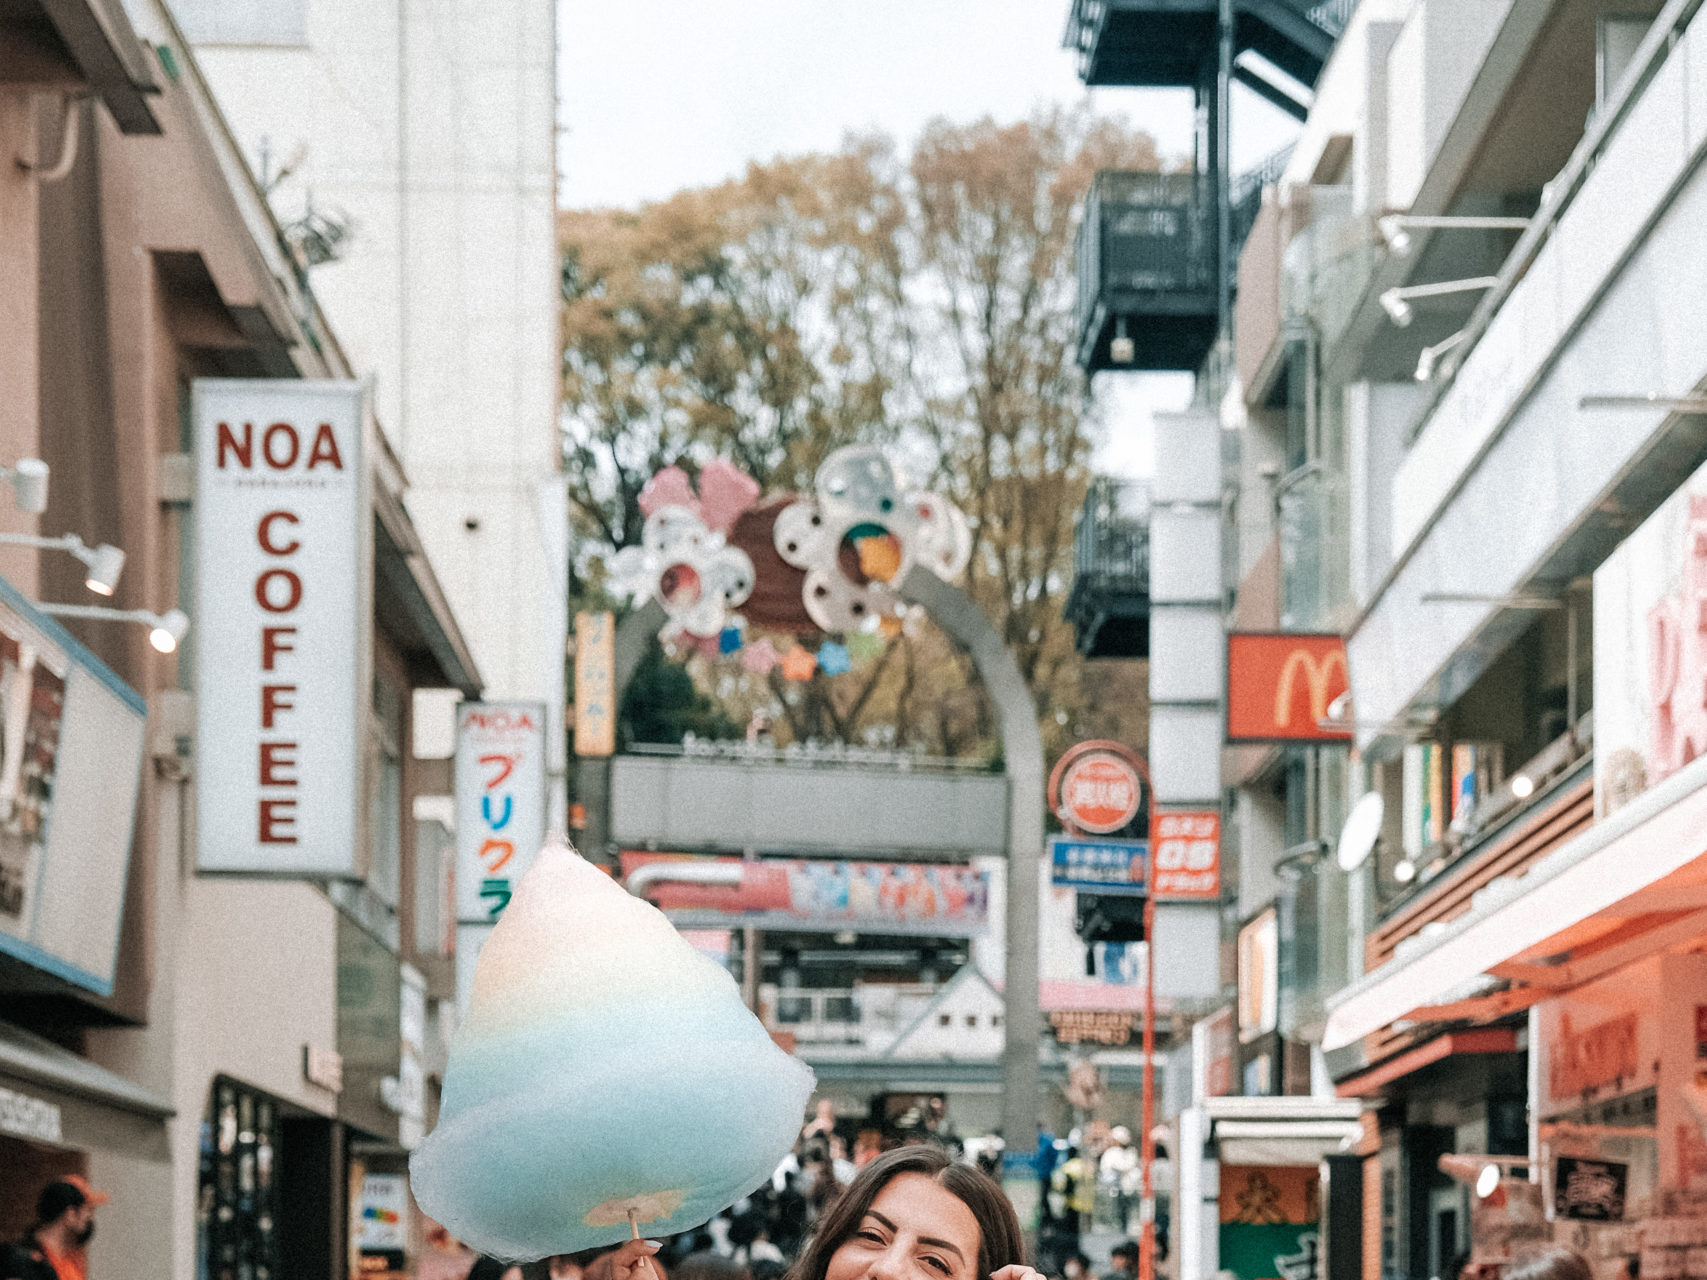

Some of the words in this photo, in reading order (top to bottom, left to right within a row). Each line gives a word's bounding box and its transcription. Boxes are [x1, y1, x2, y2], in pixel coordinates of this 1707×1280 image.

[216, 422, 343, 471] NOA
[255, 511, 303, 844] COFFEE
[464, 711, 534, 734] NOA
[478, 752, 522, 917] プリクラ
